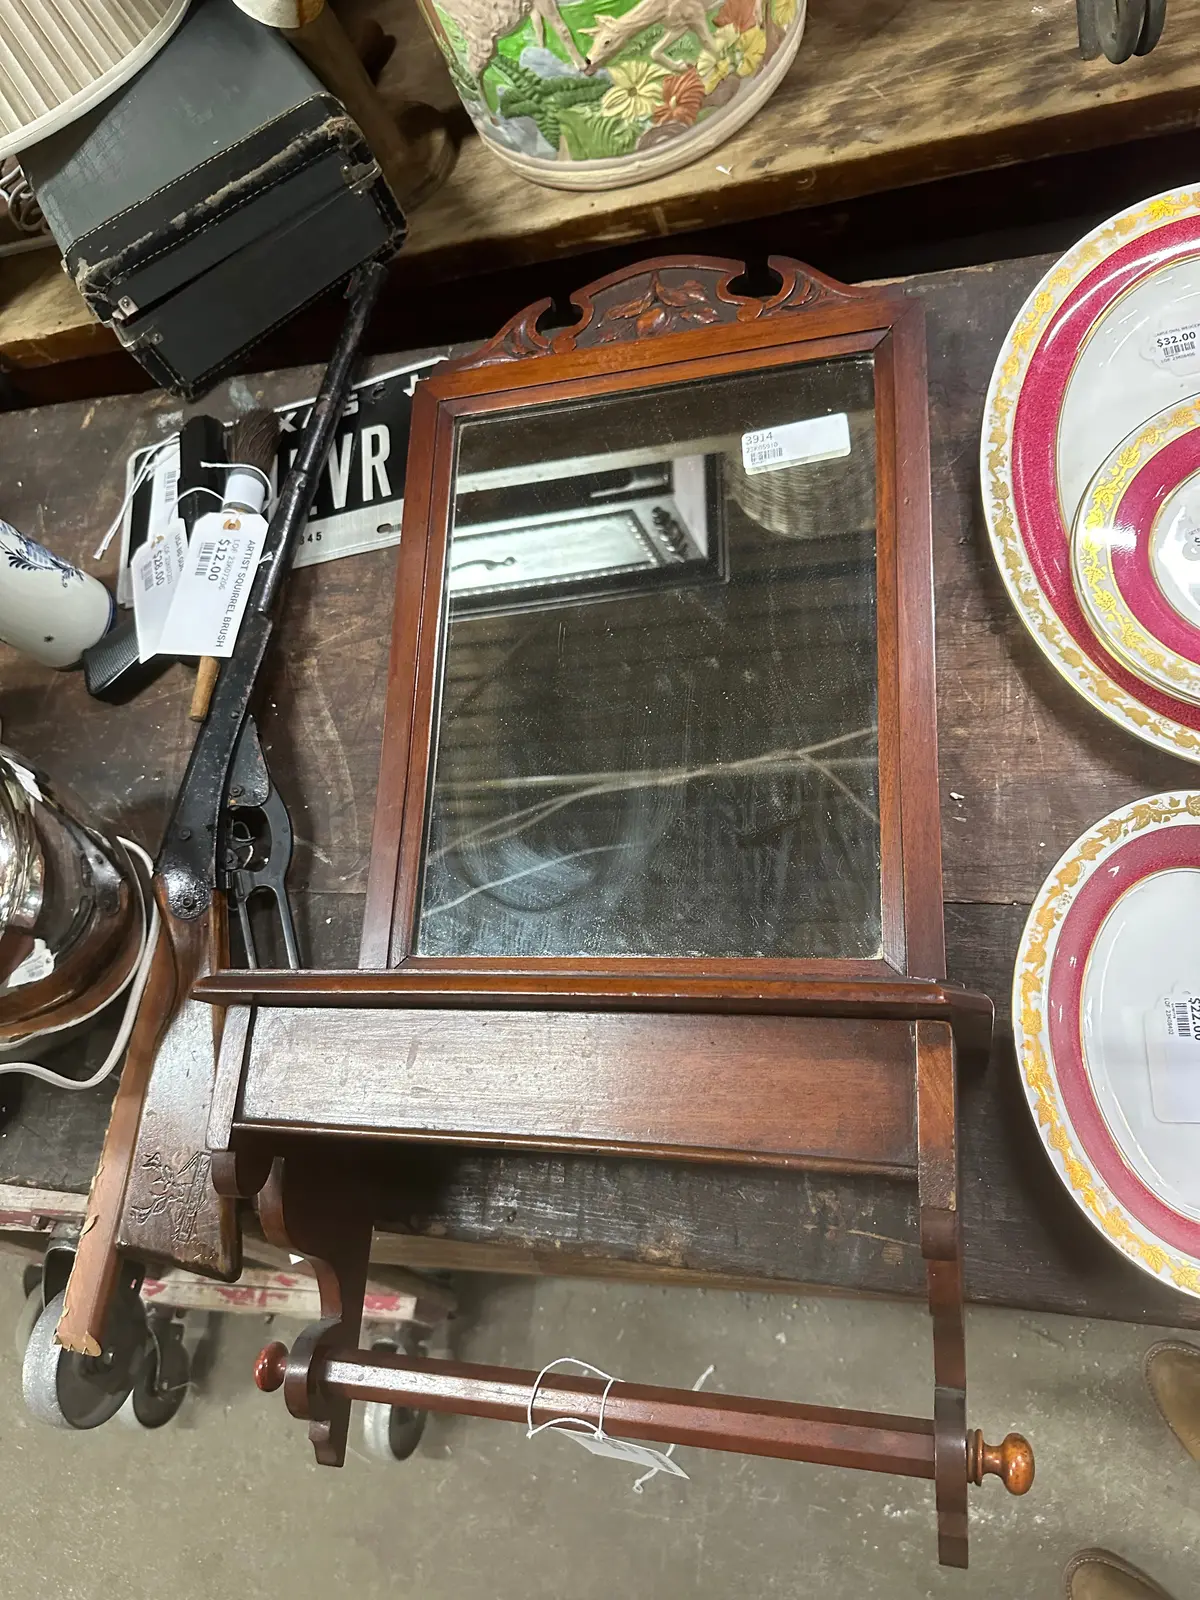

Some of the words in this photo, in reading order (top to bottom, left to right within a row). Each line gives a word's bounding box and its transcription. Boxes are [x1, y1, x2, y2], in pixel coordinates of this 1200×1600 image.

[1156, 331, 1196, 348] $32.00
[745, 431, 773, 446] 3914
[153, 550, 165, 586] $28.00
[208, 538, 231, 581] $12.00
[240, 539, 256, 571] ARTIST
[225, 572, 246, 614] SQUIRREL
[215, 616, 232, 648] BRUSH
[1188, 997, 1200, 1041] $22.00
